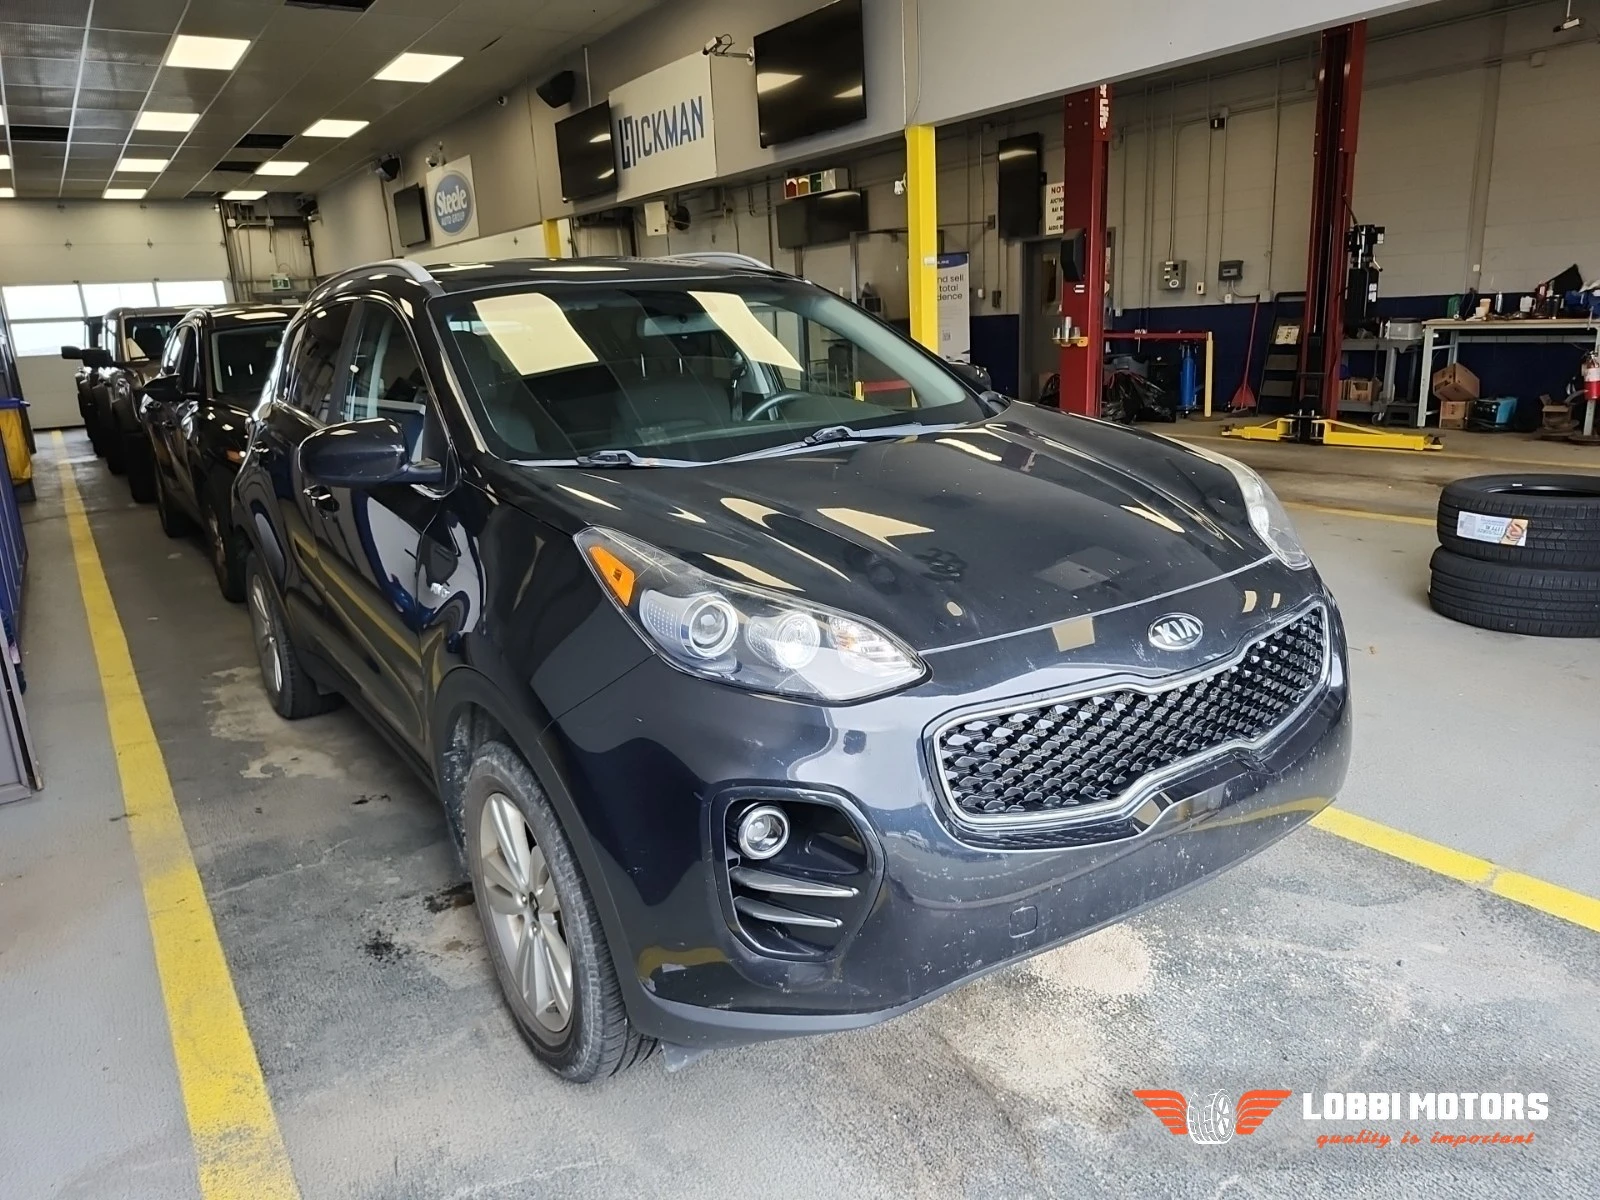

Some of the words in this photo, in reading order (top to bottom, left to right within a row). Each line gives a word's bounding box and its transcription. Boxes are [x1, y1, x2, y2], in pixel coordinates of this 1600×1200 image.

[1100, 98, 1109, 130] Lifts
[618, 95, 704, 170] HICKMAN
[436, 185, 468, 217] Steele
[939, 284, 958, 292] total
[950, 274, 964, 283] sell
[1154, 618, 1200, 644] KIA
